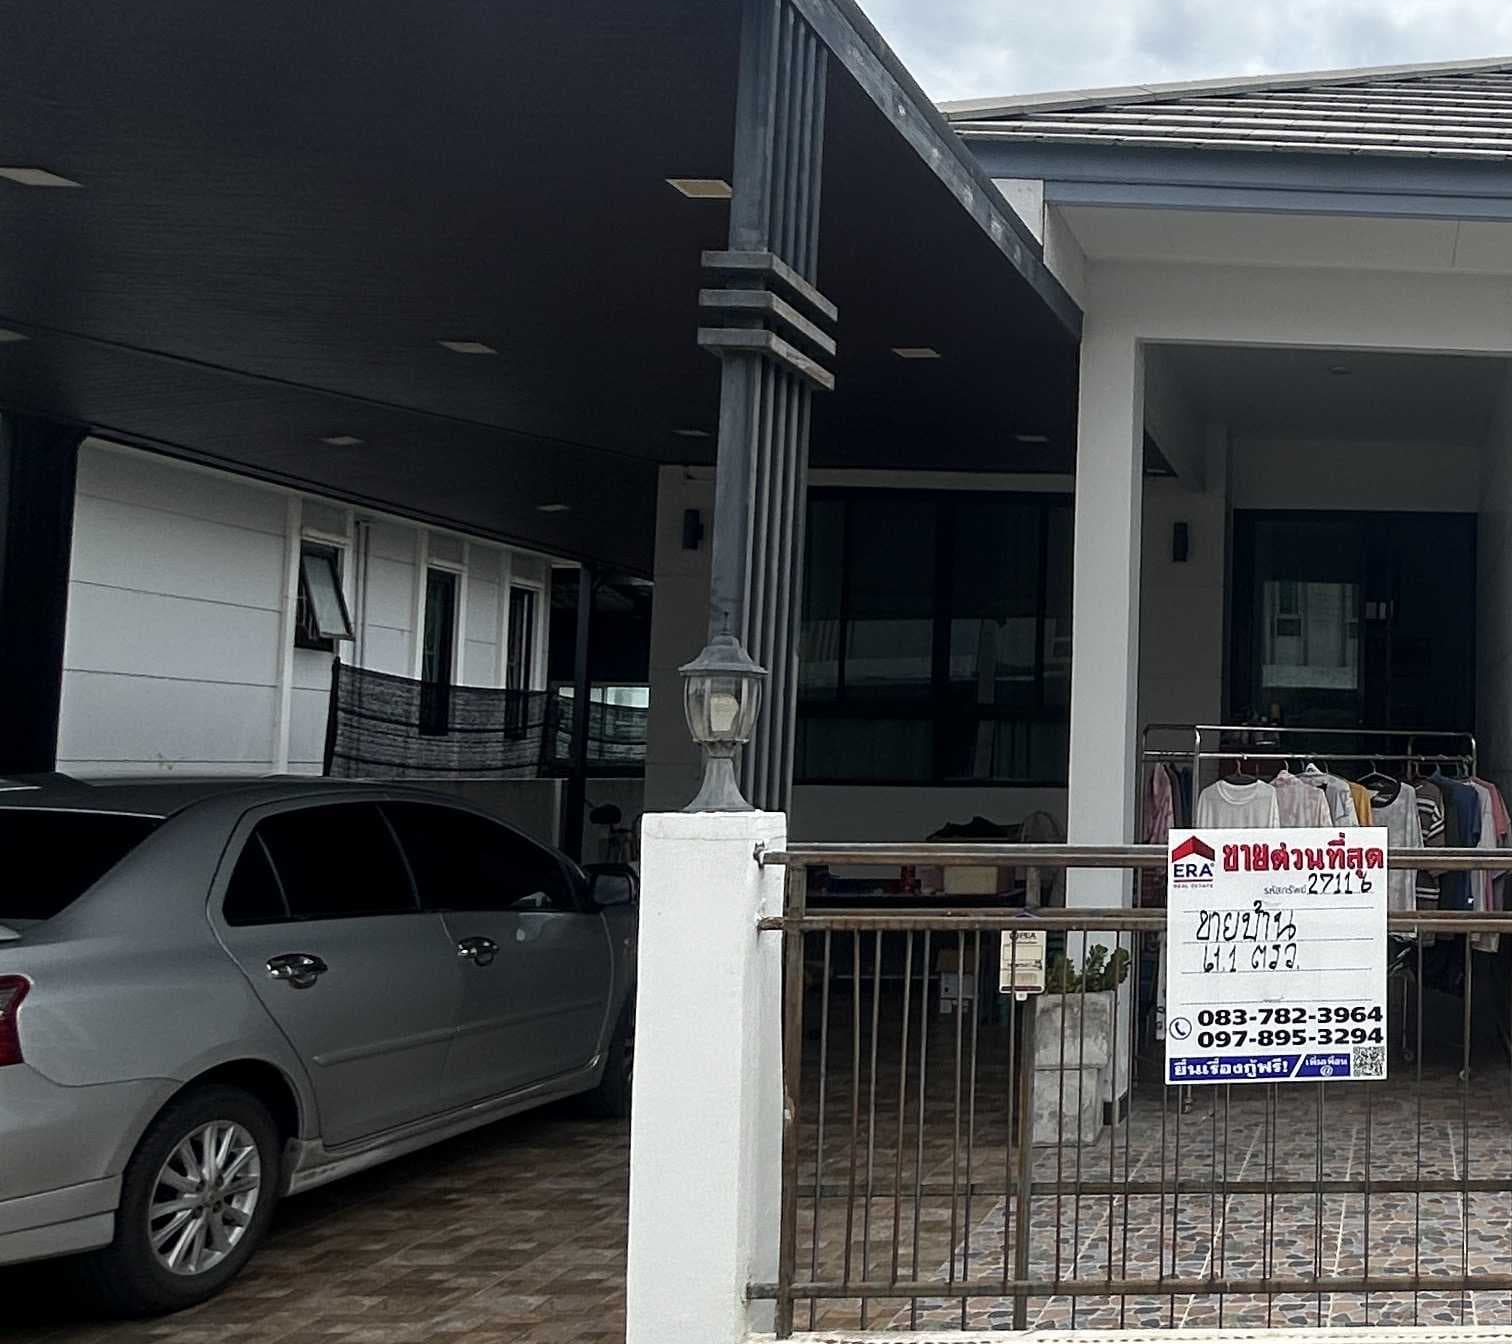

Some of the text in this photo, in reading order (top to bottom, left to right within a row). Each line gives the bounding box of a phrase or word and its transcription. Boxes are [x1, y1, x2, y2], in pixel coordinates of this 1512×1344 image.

[1222, 832, 1384, 879] ขายด่วนที่สุด
[1173, 863, 1213, 878] ERA
[1196, 900, 1297, 942] ขายบ้าน
[1198, 1006, 1383, 1026] 083-782-3964
[1198, 1027, 1384, 1048] 097-895-3294
